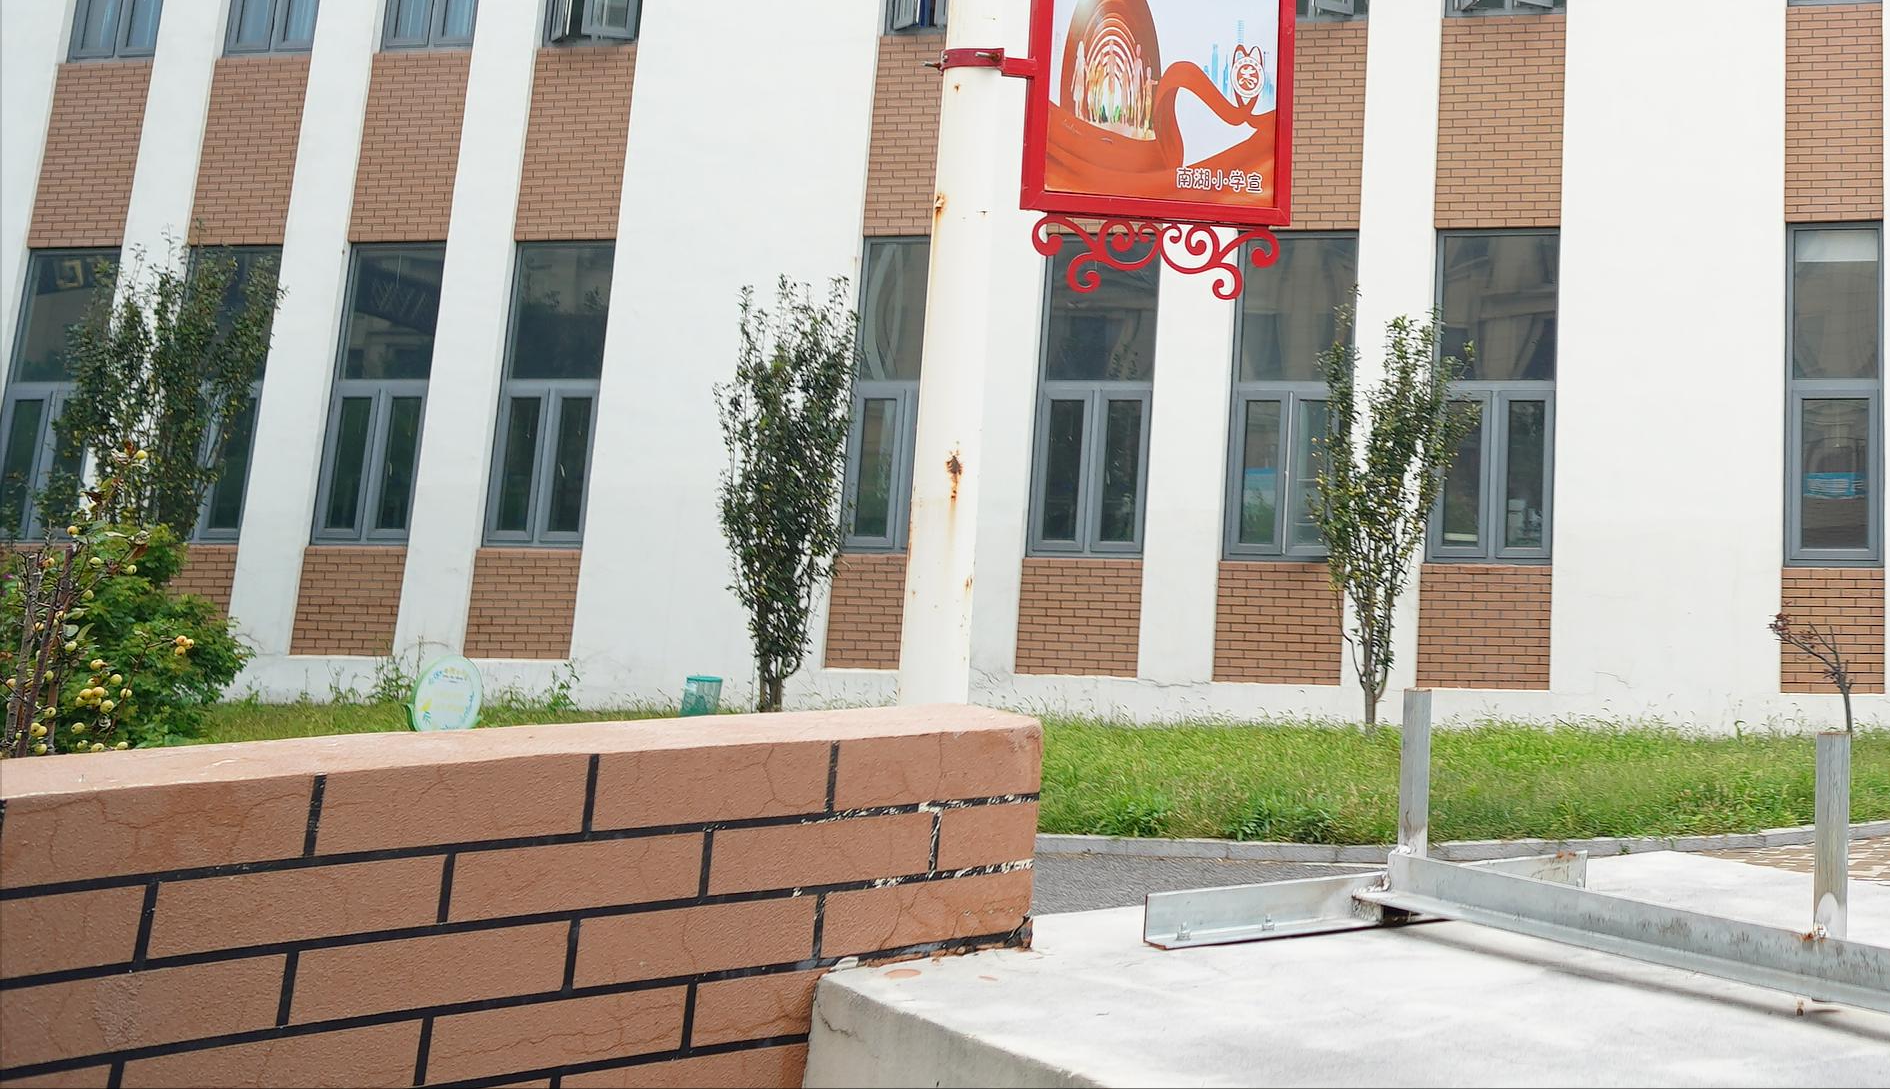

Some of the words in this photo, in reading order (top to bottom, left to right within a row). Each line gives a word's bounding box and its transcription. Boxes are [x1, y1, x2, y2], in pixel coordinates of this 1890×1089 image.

[1176, 167, 1263, 193] 南湖小学宣
